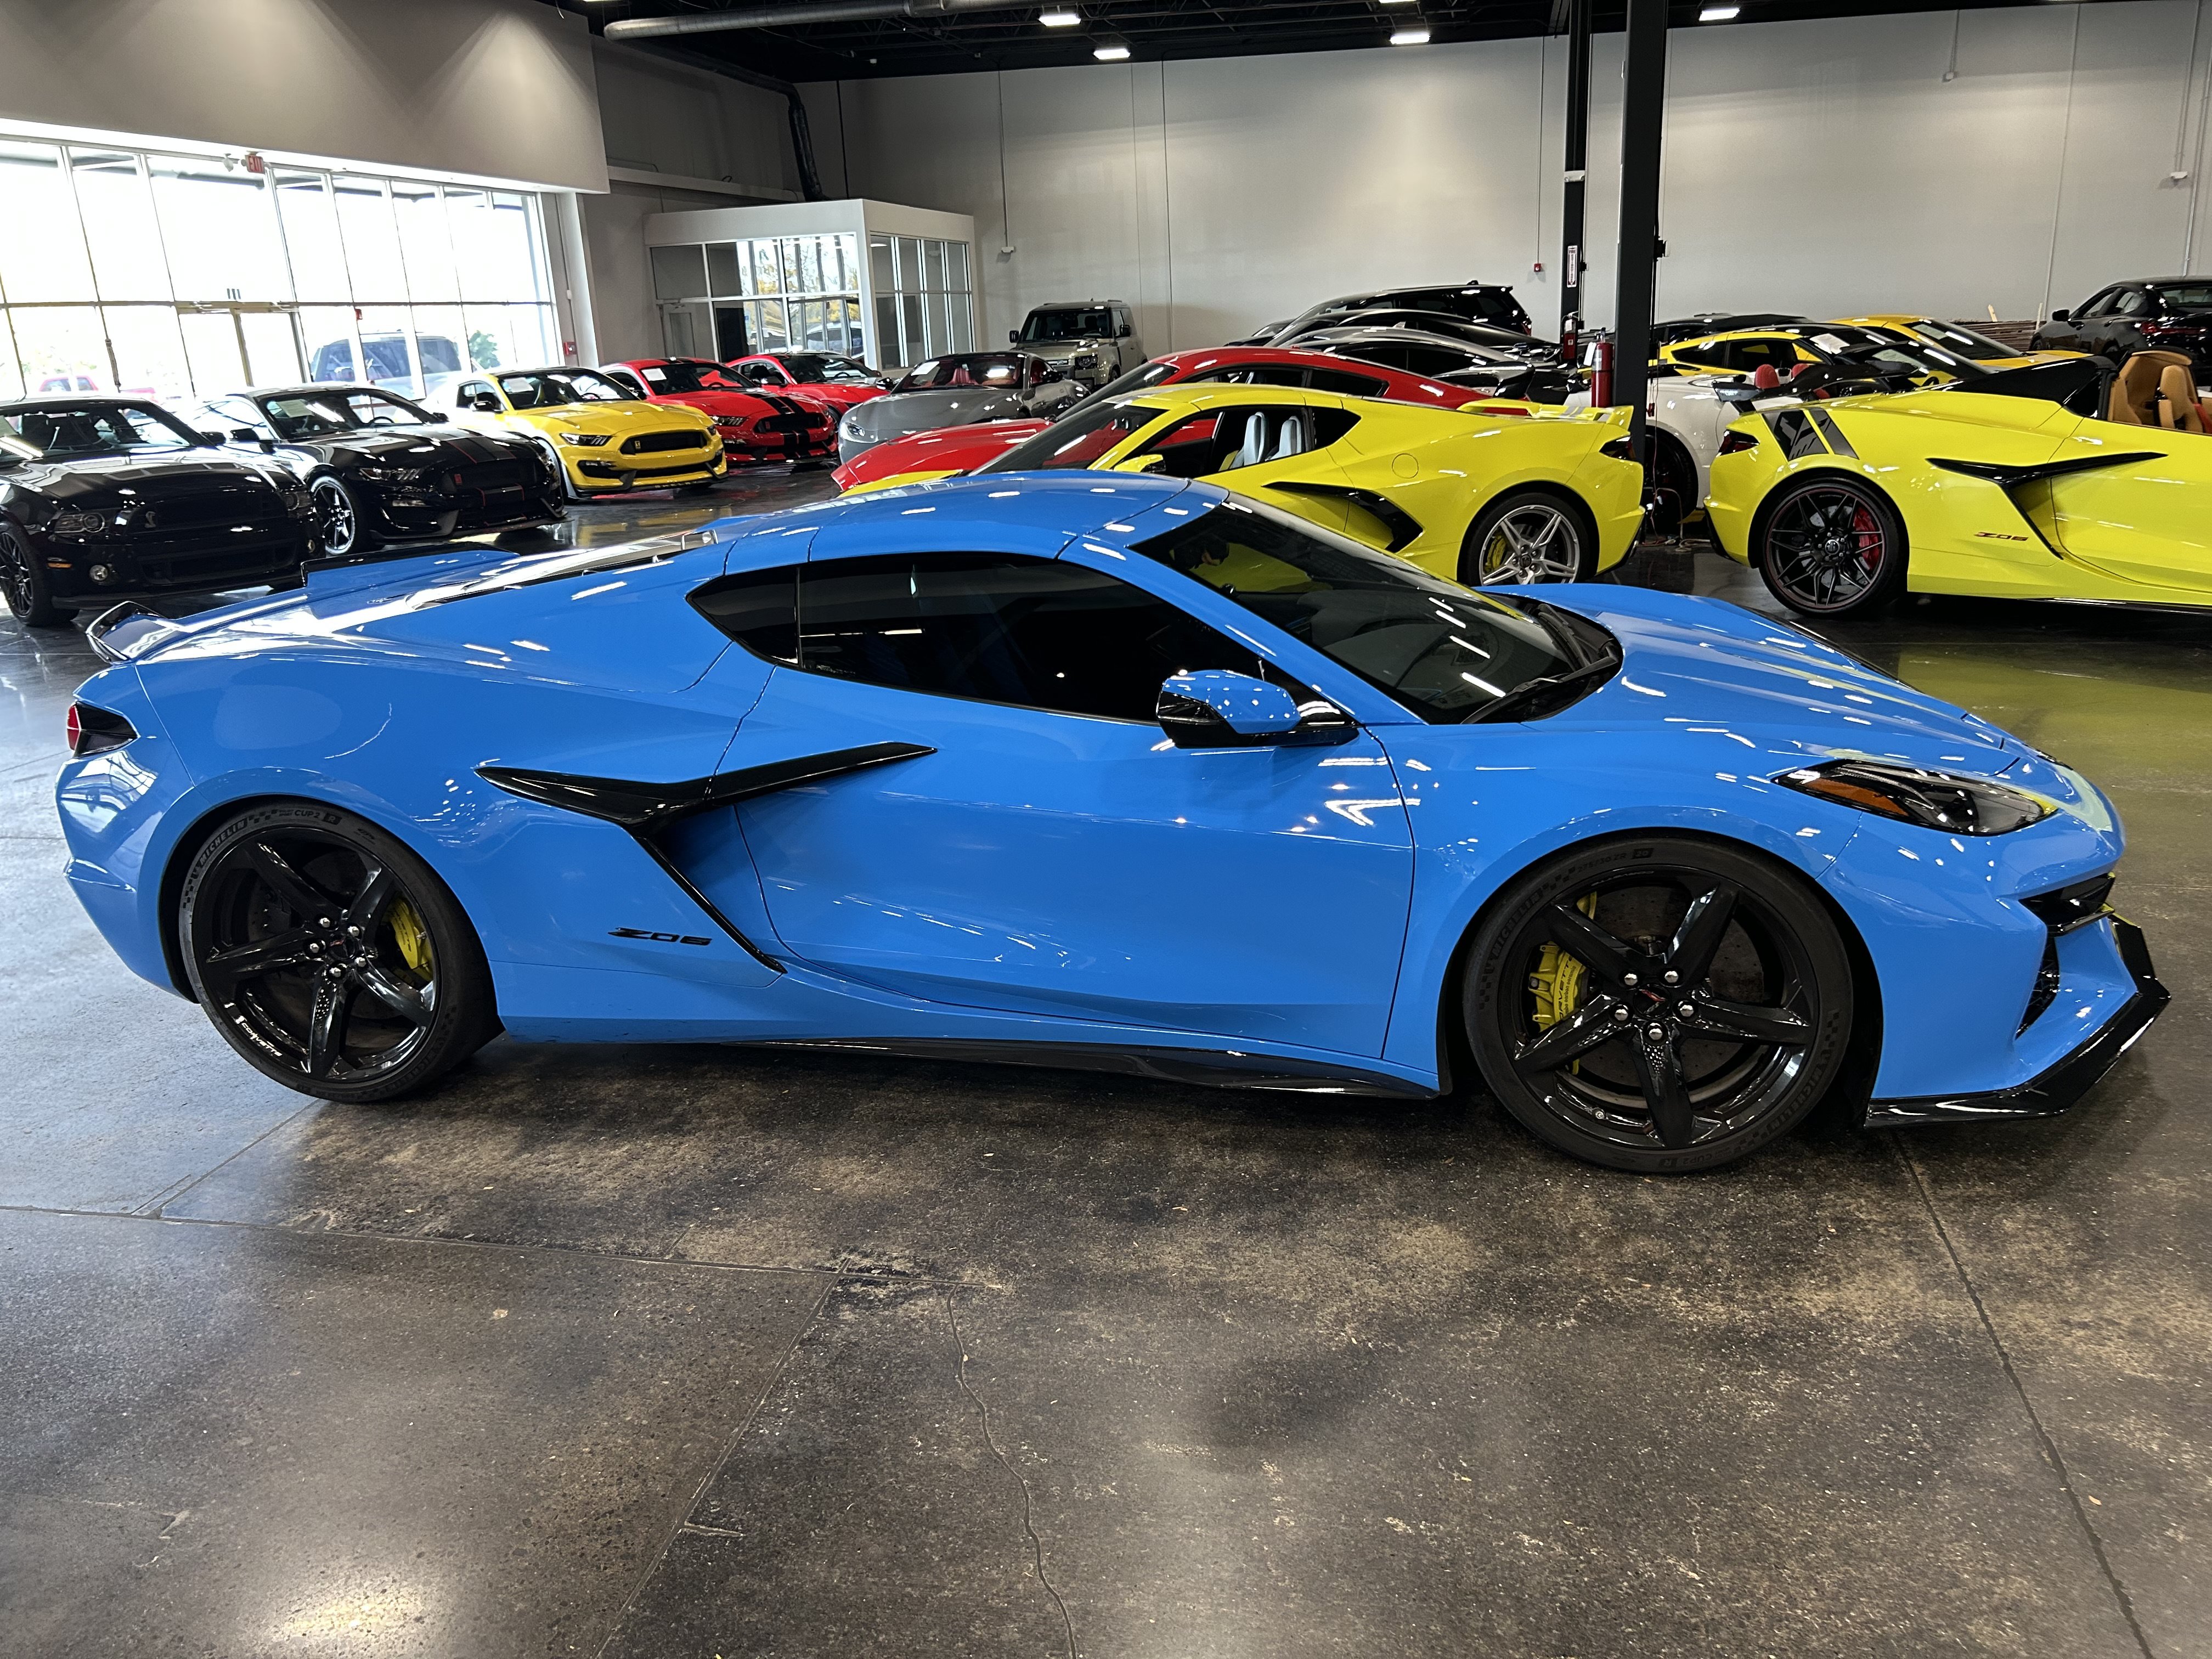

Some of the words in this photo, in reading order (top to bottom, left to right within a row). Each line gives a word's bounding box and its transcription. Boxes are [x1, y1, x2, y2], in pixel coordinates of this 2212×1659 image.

[249, 156, 262, 171] EXIT
[1973, 532, 2029, 541] Z06
[199, 820, 245, 866] MICHELIN
[1492, 892, 1540, 956] MICHELIN
[608, 927, 713, 945] Z06
